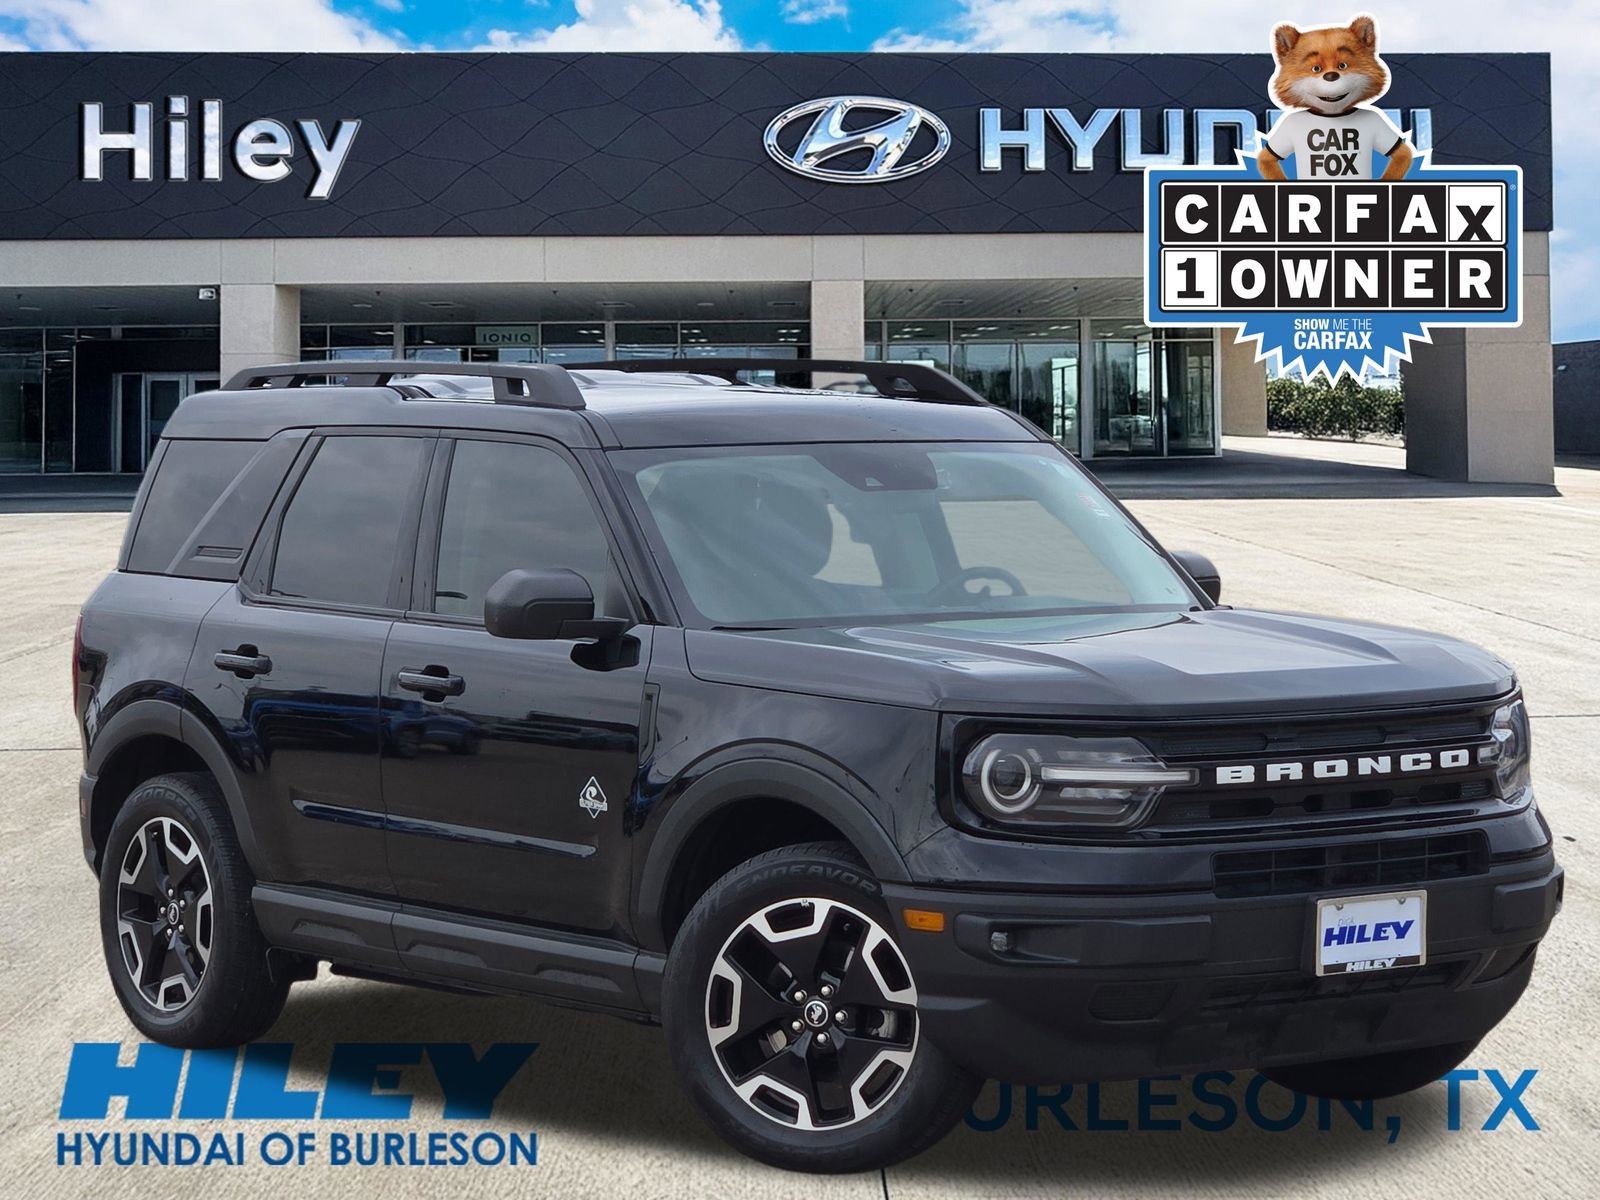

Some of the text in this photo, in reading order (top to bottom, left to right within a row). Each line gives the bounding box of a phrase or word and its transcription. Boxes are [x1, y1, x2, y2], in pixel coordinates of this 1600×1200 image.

[79, 95, 361, 199] Hiley
[980, 107, 1432, 171] HYUNI
[1216, 749, 1469, 785] BRONCO
[737, 864, 877, 894] ENDEAVOR
[1323, 919, 1415, 947] HILEY
[1345, 957, 1397, 972] HILEY
